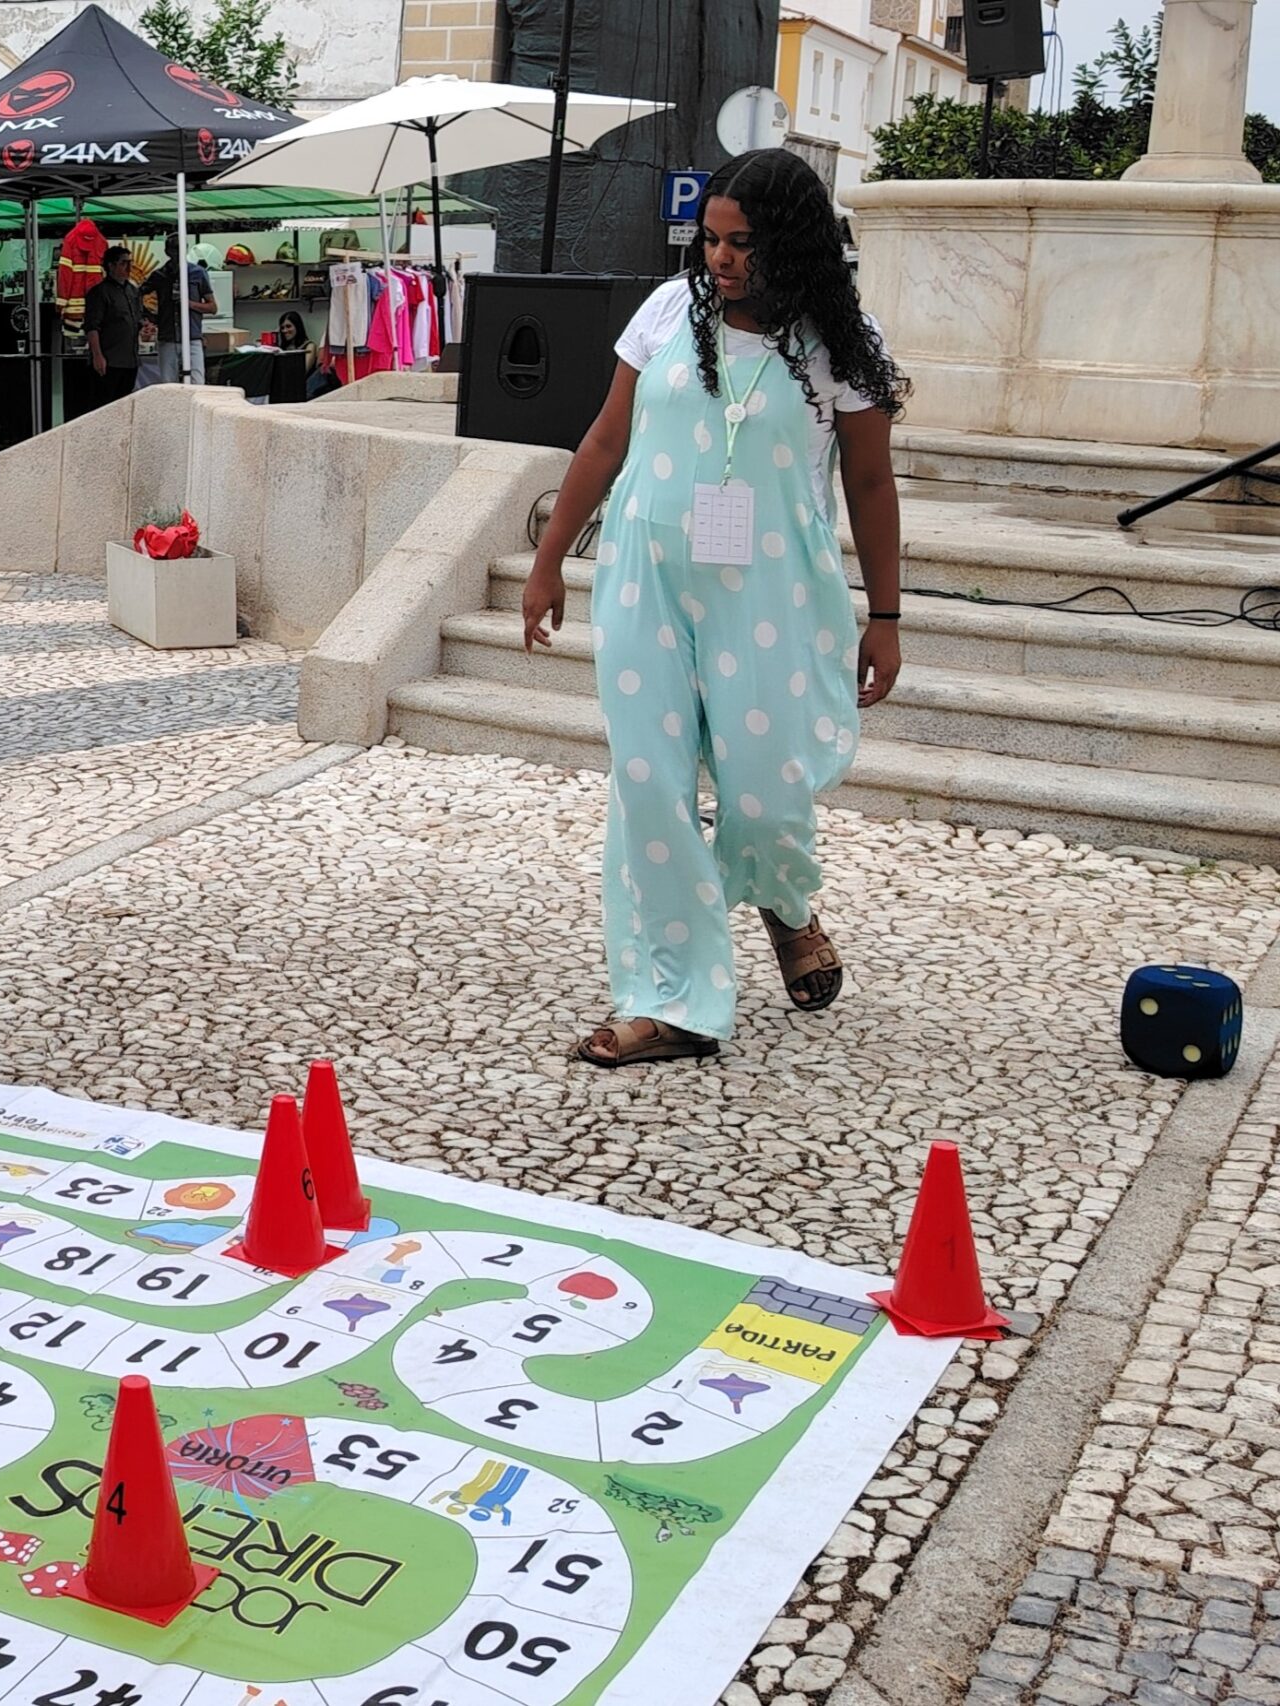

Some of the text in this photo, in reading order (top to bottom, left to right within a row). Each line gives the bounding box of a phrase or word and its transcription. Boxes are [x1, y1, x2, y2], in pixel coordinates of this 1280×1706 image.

[39, 140, 151, 165] 24MX
[217, 137, 261, 160] 24M
[671, 176, 700, 216] P
[55, 1177, 134, 1205] 23
[301, 1167, 315, 1201] 6
[43, 1246, 116, 1276] 18
[482, 1243, 524, 1267] 7
[136, 1266, 210, 1300] 19
[9, 1312, 86, 1348] 12
[512, 1313, 562, 1344] 5
[724, 1322, 838, 1362] PARTIDA
[125, 1338, 201, 1373] 11
[244, 1332, 321, 1369] 10
[432, 1338, 478, 1365] 4
[484, 1398, 539, 1430] 3
[631, 1411, 683, 1446] 2
[323, 1434, 420, 1481] 53
[106, 1481, 127, 1525] 4
[547, 1498, 580, 1514] 52
[508, 1538, 603, 1595] 51
[463, 1620, 571, 1677] 50
